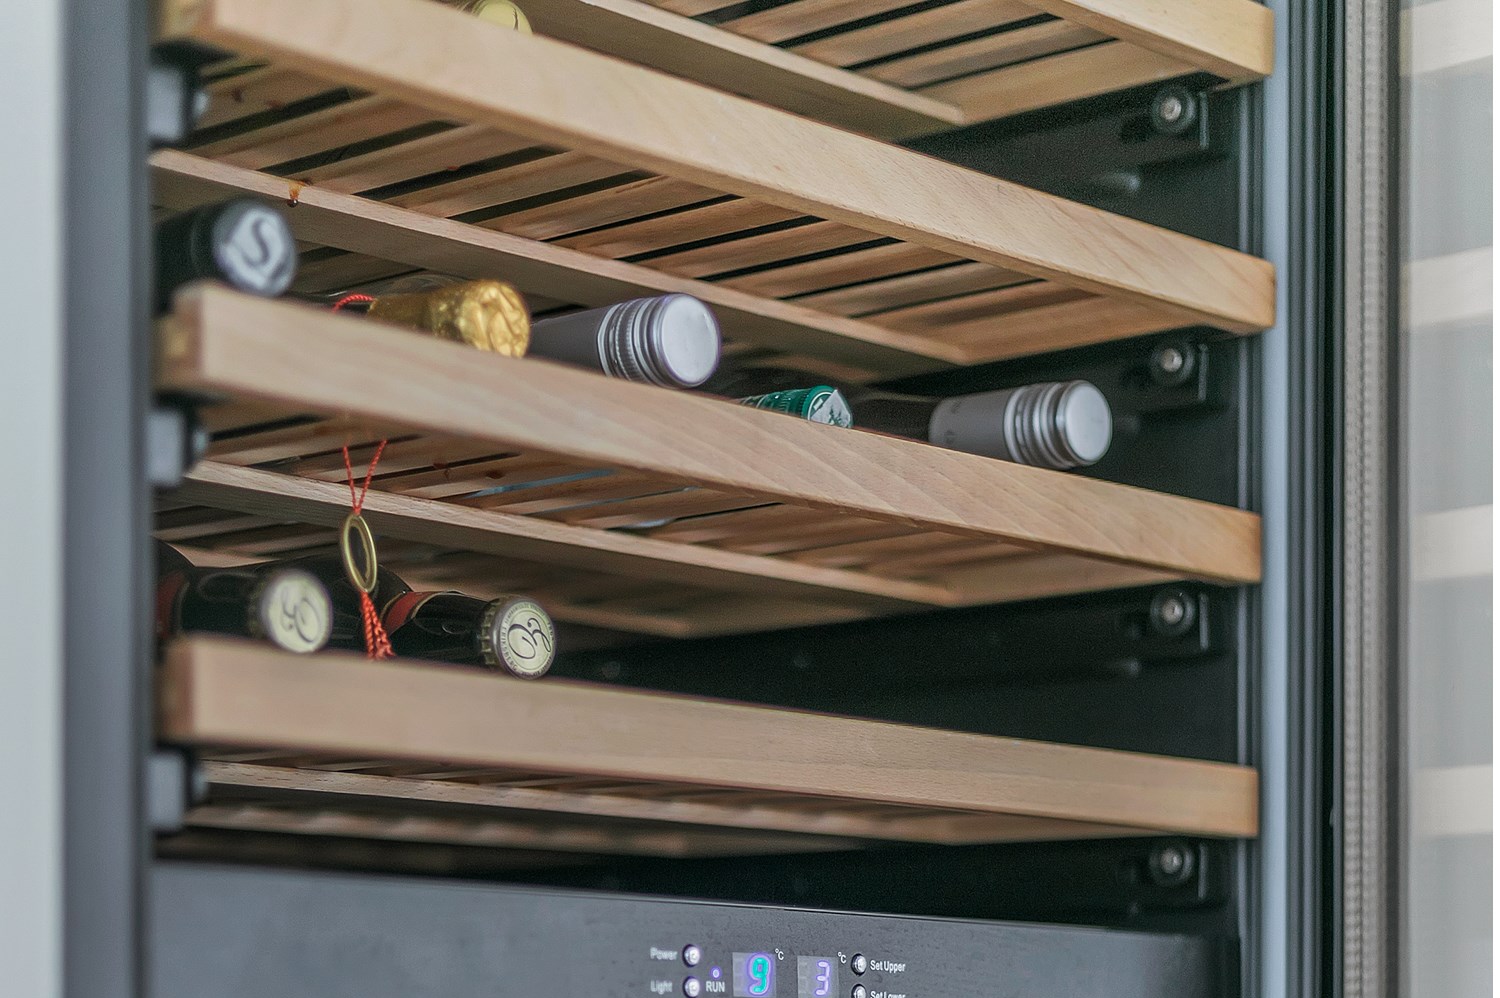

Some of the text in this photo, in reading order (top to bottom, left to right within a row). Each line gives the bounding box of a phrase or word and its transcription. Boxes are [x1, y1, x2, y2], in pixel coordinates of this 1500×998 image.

[650, 947, 678, 961] Power
[870, 959, 906, 974] Set Upper
[751, 955, 770, 995] 9
[815, 961, 831, 996] 3
[650, 980, 673, 995] Light
[705, 980, 726, 993] RUN
